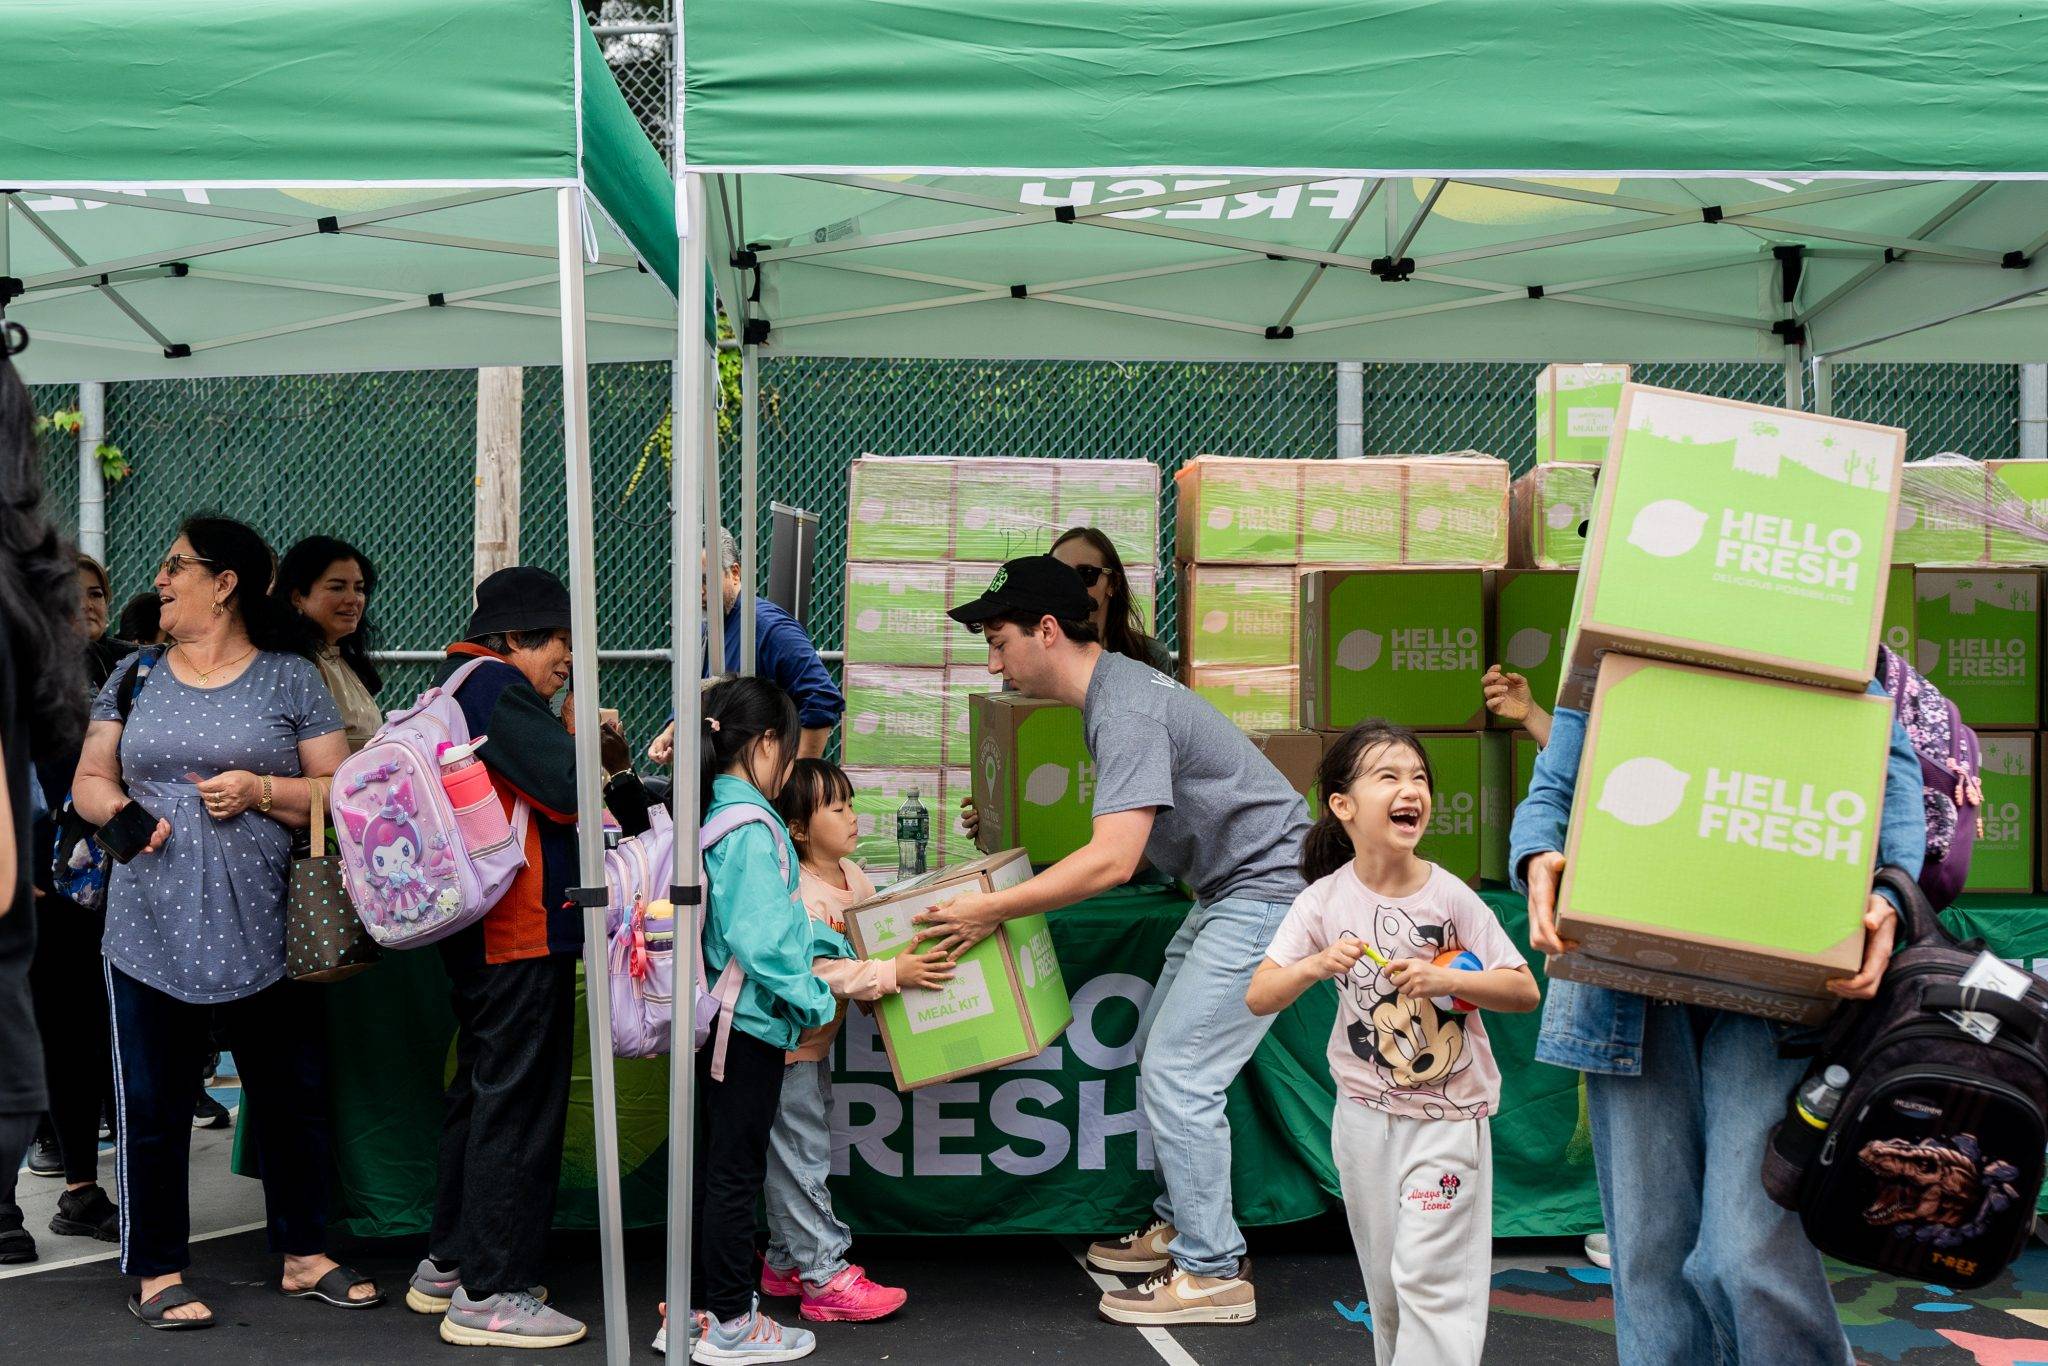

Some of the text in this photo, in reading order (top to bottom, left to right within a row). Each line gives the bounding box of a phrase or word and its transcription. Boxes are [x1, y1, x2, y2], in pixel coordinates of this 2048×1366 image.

[1720, 507, 1862, 559] HELLO
[1715, 538, 1858, 591] FRESH
[1233, 609, 1284, 622] HELLO
[1233, 622, 1284, 635] FRESH
[1391, 627, 1478, 650] HELLO
[1610, 640, 1642, 653] THIS
[1646, 648, 1678, 660] BOX
[1681, 654, 1696, 662] IS
[1700, 657, 1741, 671] 100%
[1949, 638, 2025, 657] HELLO
[1391, 649, 1478, 671] FRESH
[1948, 658, 2026, 677] FRESH
[1704, 767, 1866, 826] HELLO
[1698, 803, 1863, 865] FRESH
[918, 995, 979, 1022] MEAL KIT
[831, 1076, 1155, 1178] RESH
[1408, 1188, 1440, 1200] Always
[1422, 1200, 1451, 1211] Iconic
[1931, 1252, 1978, 1272] T-REX
